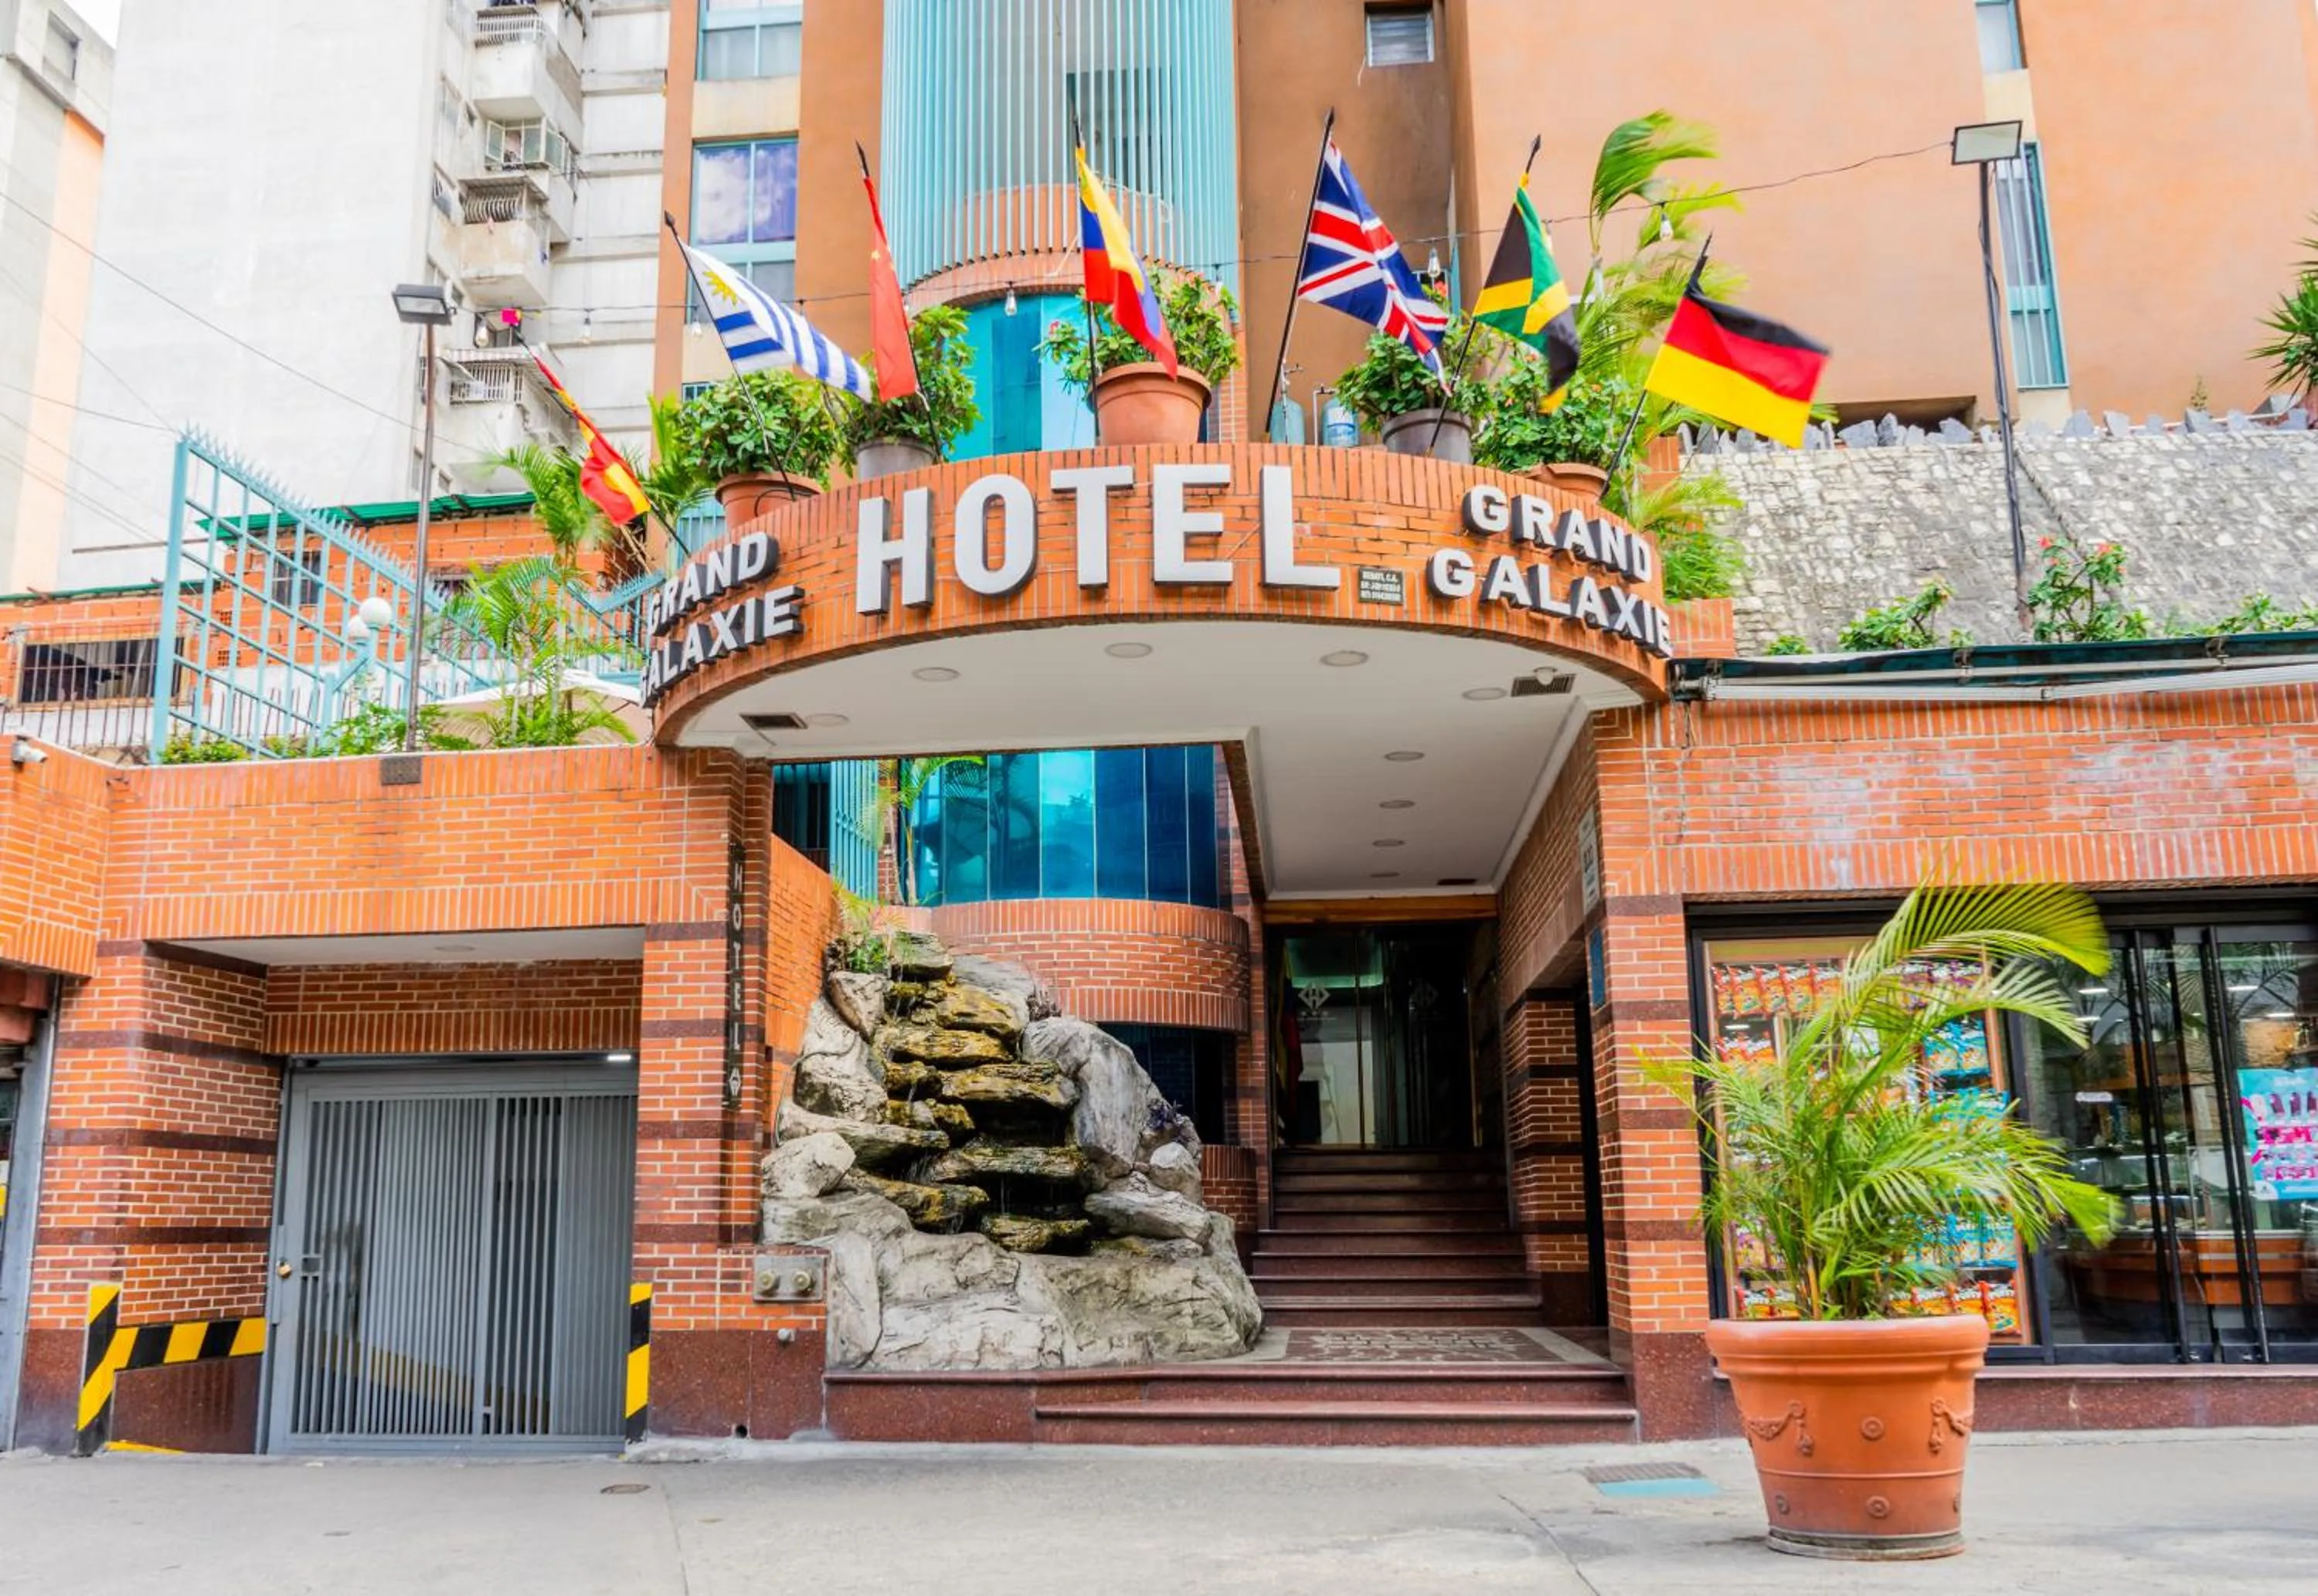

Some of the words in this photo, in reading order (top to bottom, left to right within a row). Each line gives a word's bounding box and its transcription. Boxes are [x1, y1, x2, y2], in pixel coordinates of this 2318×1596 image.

[647, 531, 773, 637] GRAND
[856, 464, 1340, 616] HOTEL
[1467, 484, 1652, 582] GRAND
[1429, 548, 1673, 657] GALAXIE
[732, 862, 743, 1051] HOTEL
